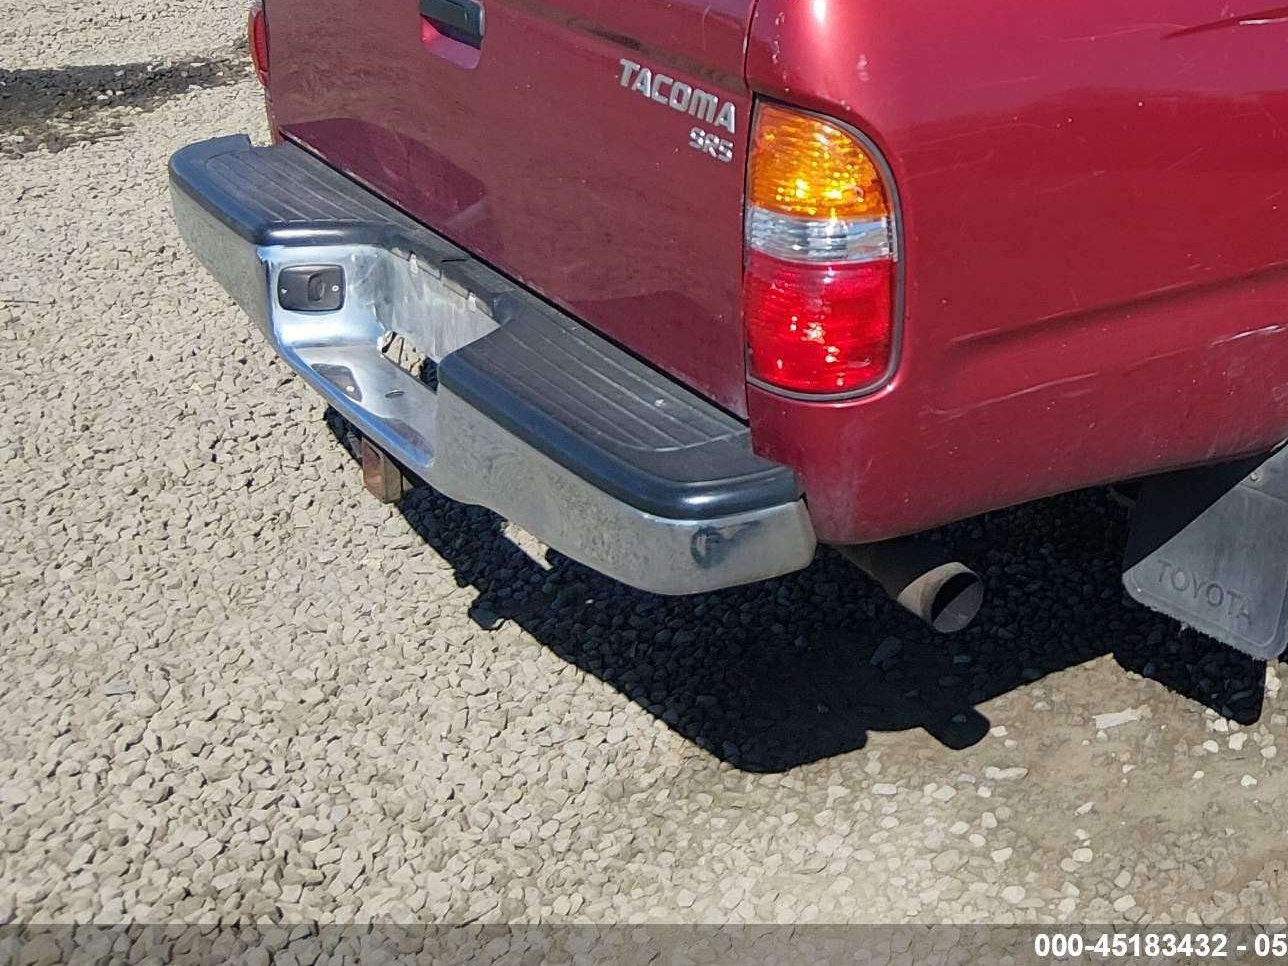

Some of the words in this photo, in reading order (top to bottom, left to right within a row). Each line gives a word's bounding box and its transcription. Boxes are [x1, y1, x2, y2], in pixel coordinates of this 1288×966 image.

[620, 57, 736, 134] TACOMA
[688, 126, 734, 163] SR5
[1157, 558, 1253, 626] TOYOTA
